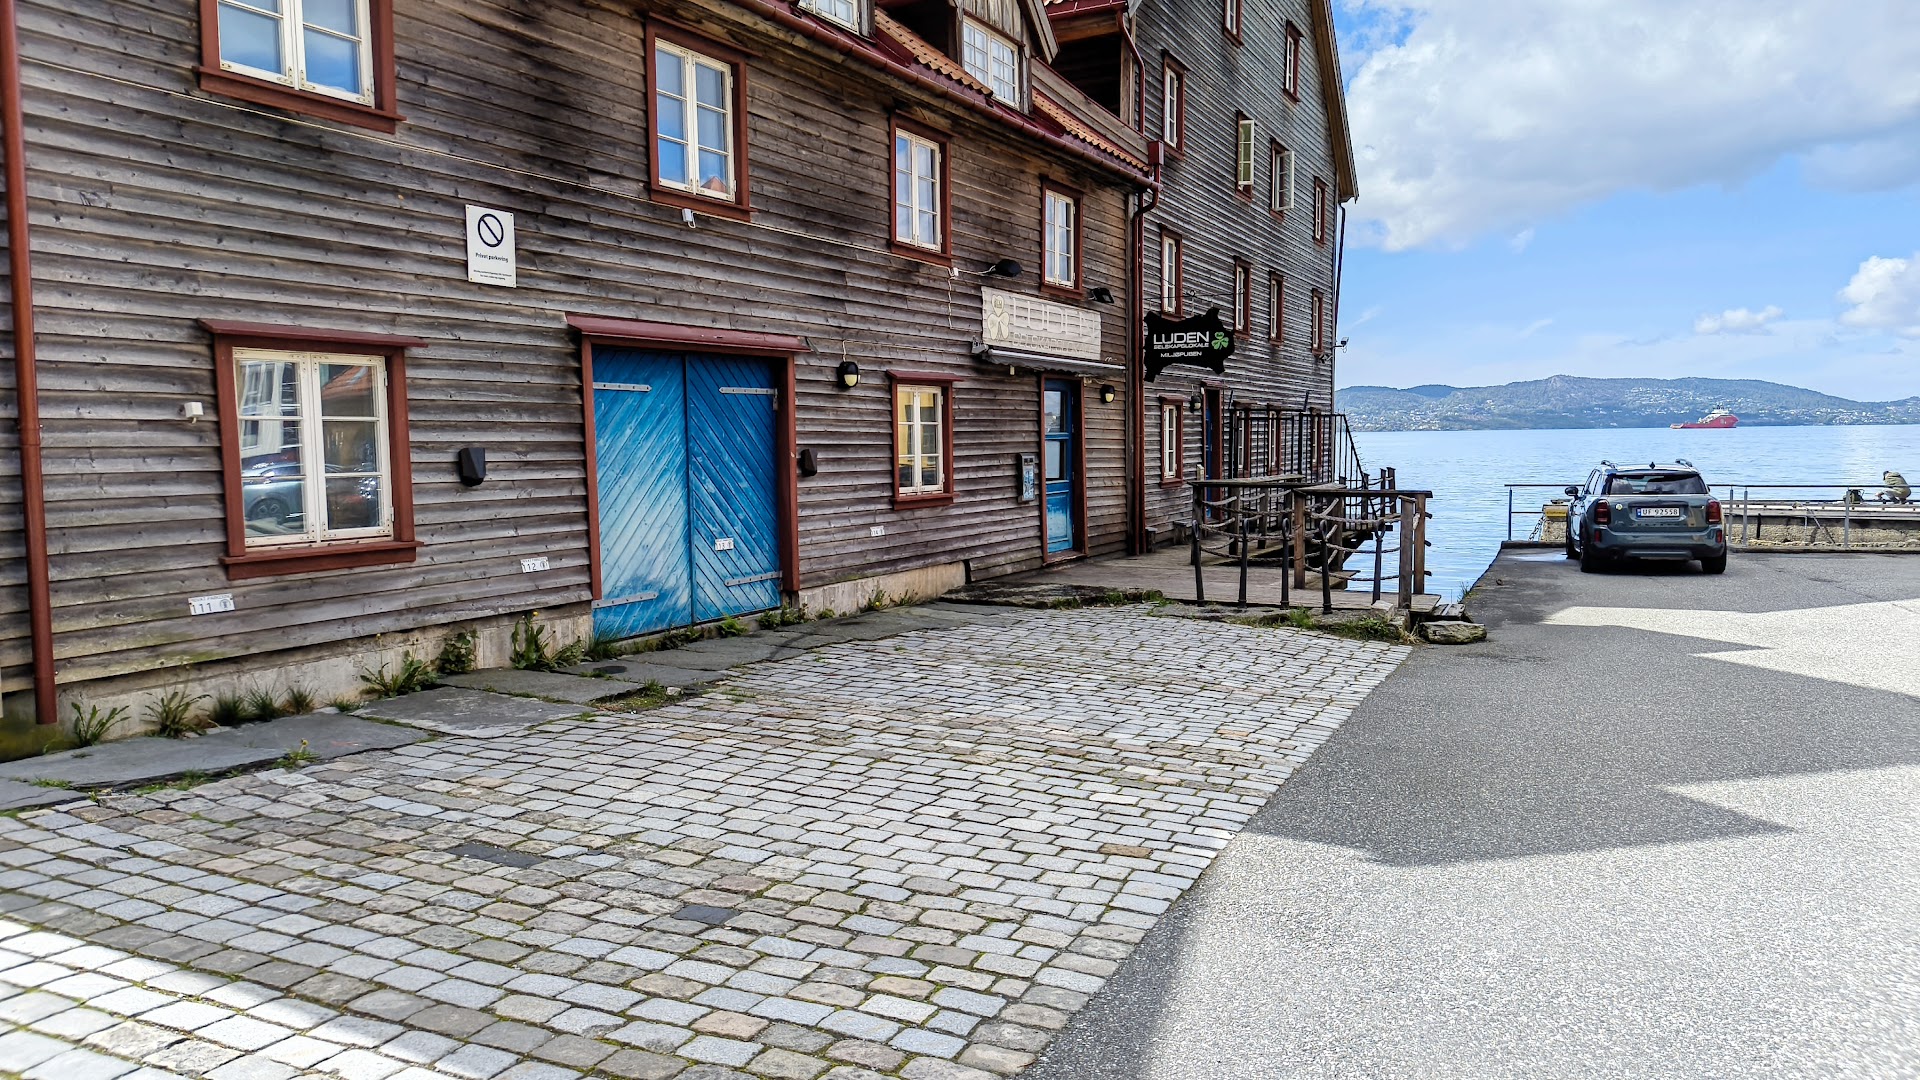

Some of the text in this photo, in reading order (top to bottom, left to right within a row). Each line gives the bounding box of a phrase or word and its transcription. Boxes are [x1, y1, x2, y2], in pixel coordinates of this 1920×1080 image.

[1013, 298, 1097, 339] LUDEN
[1153, 331, 1210, 344] LUDEN
[1654, 508, 1678, 516] 92558
[191, 602, 212, 614] 111
